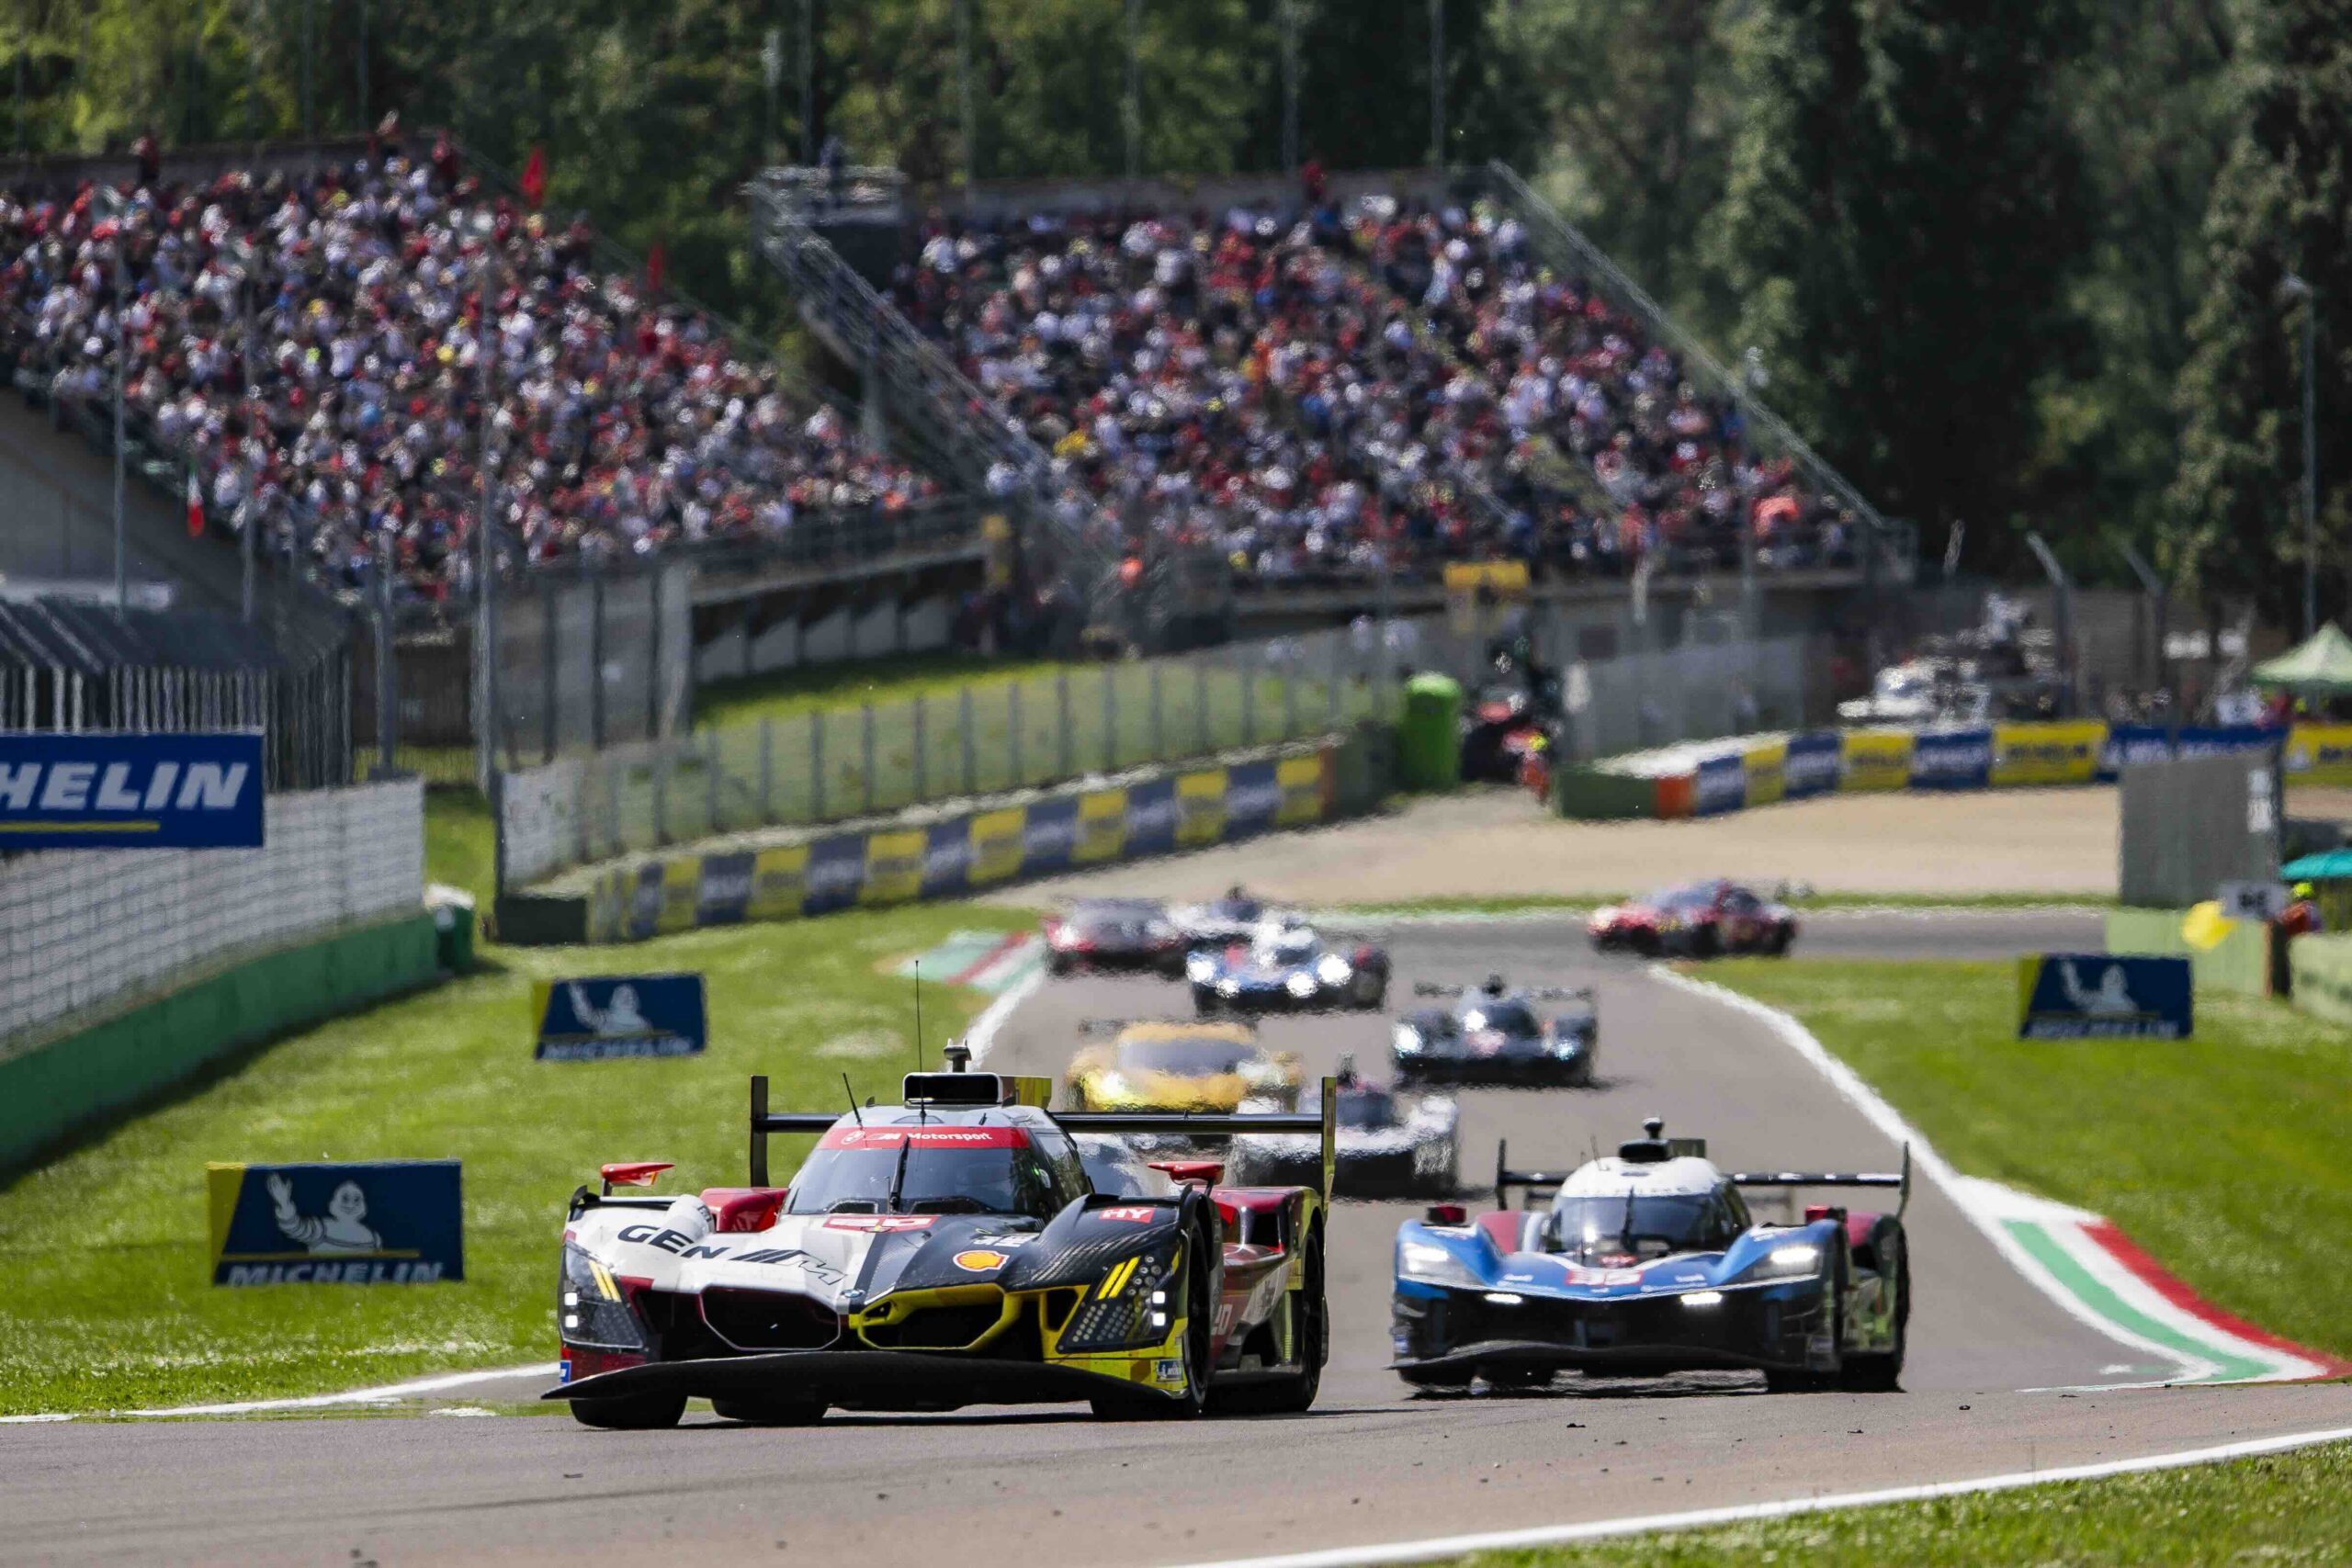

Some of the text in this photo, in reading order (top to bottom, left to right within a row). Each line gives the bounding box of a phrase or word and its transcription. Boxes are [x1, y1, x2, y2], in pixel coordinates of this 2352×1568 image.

[907, 1132, 993, 1143] Motorsport
[1102, 1208, 1151, 1219] HY
[617, 1224, 729, 1259] GEN
[226, 1261, 444, 1288] MICHELIN
